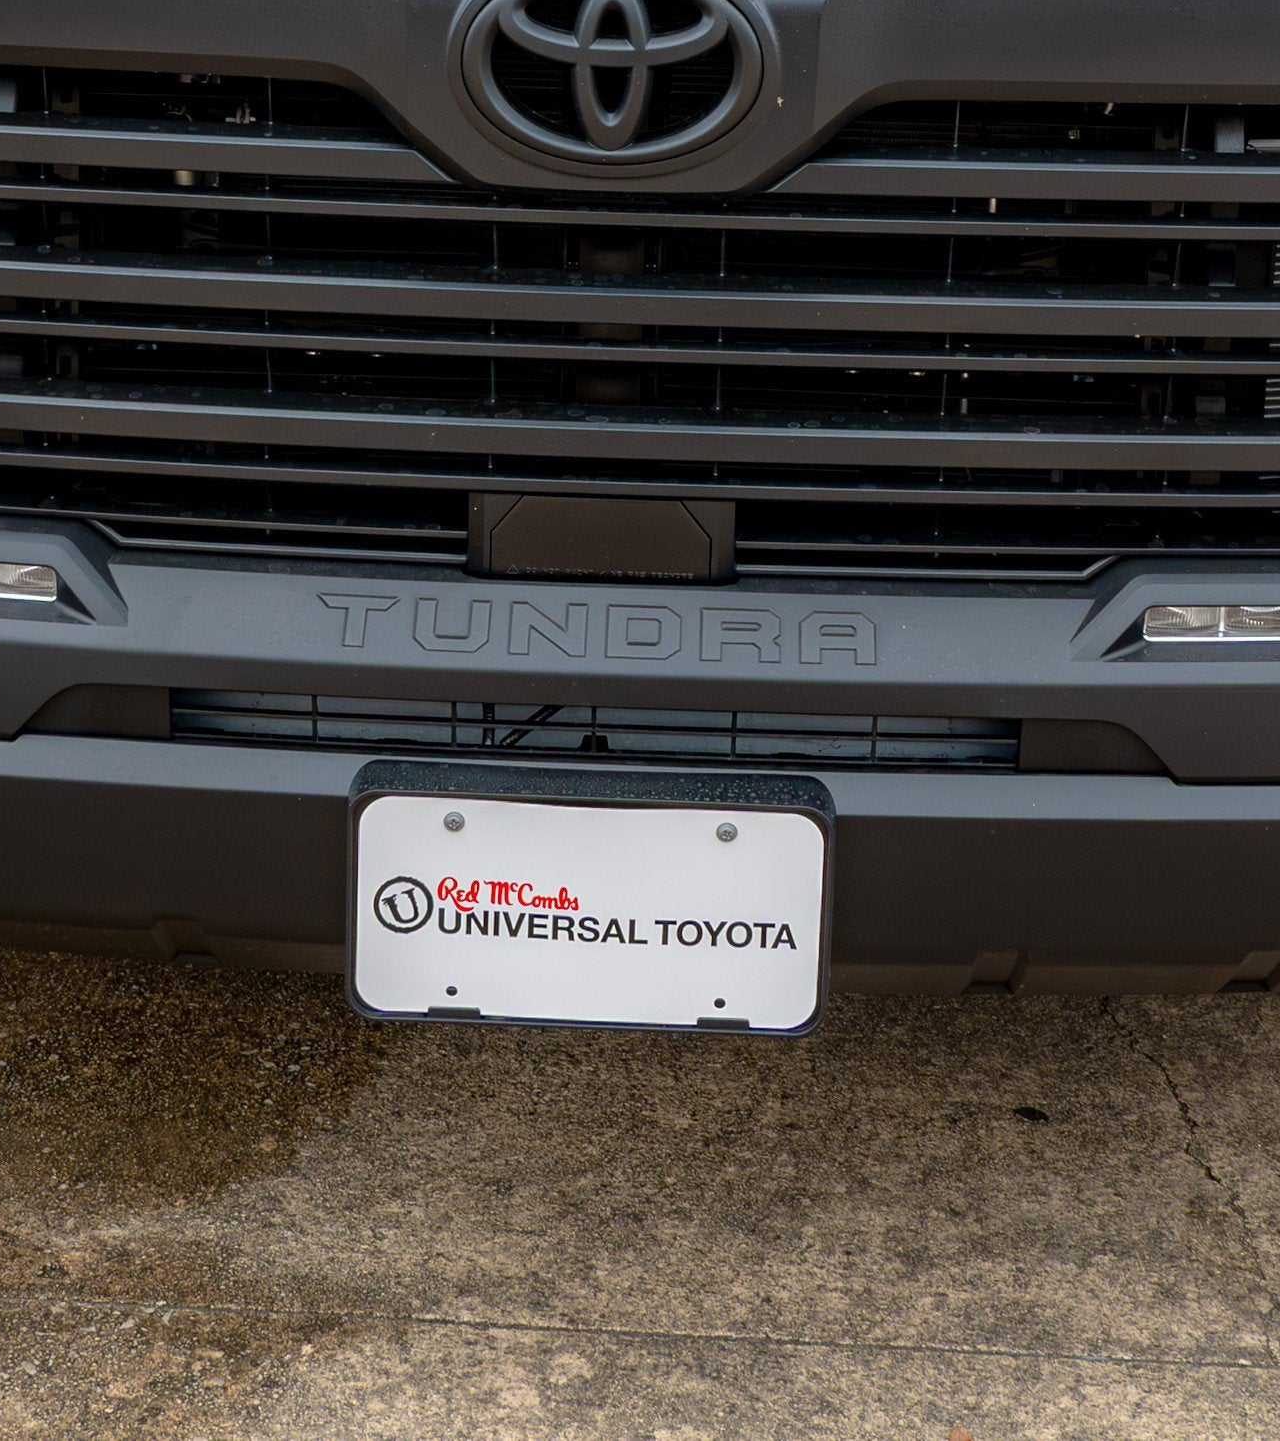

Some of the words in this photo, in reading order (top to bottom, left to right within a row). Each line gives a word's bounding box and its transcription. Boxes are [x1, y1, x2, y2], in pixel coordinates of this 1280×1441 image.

[317, 592, 877, 666] TUNDRA
[437, 876, 480, 912] Red
[483, 880, 579, 911] McCombs
[437, 907, 648, 945] UNIVERSAL
[655, 919, 798, 950] TOYOTA
